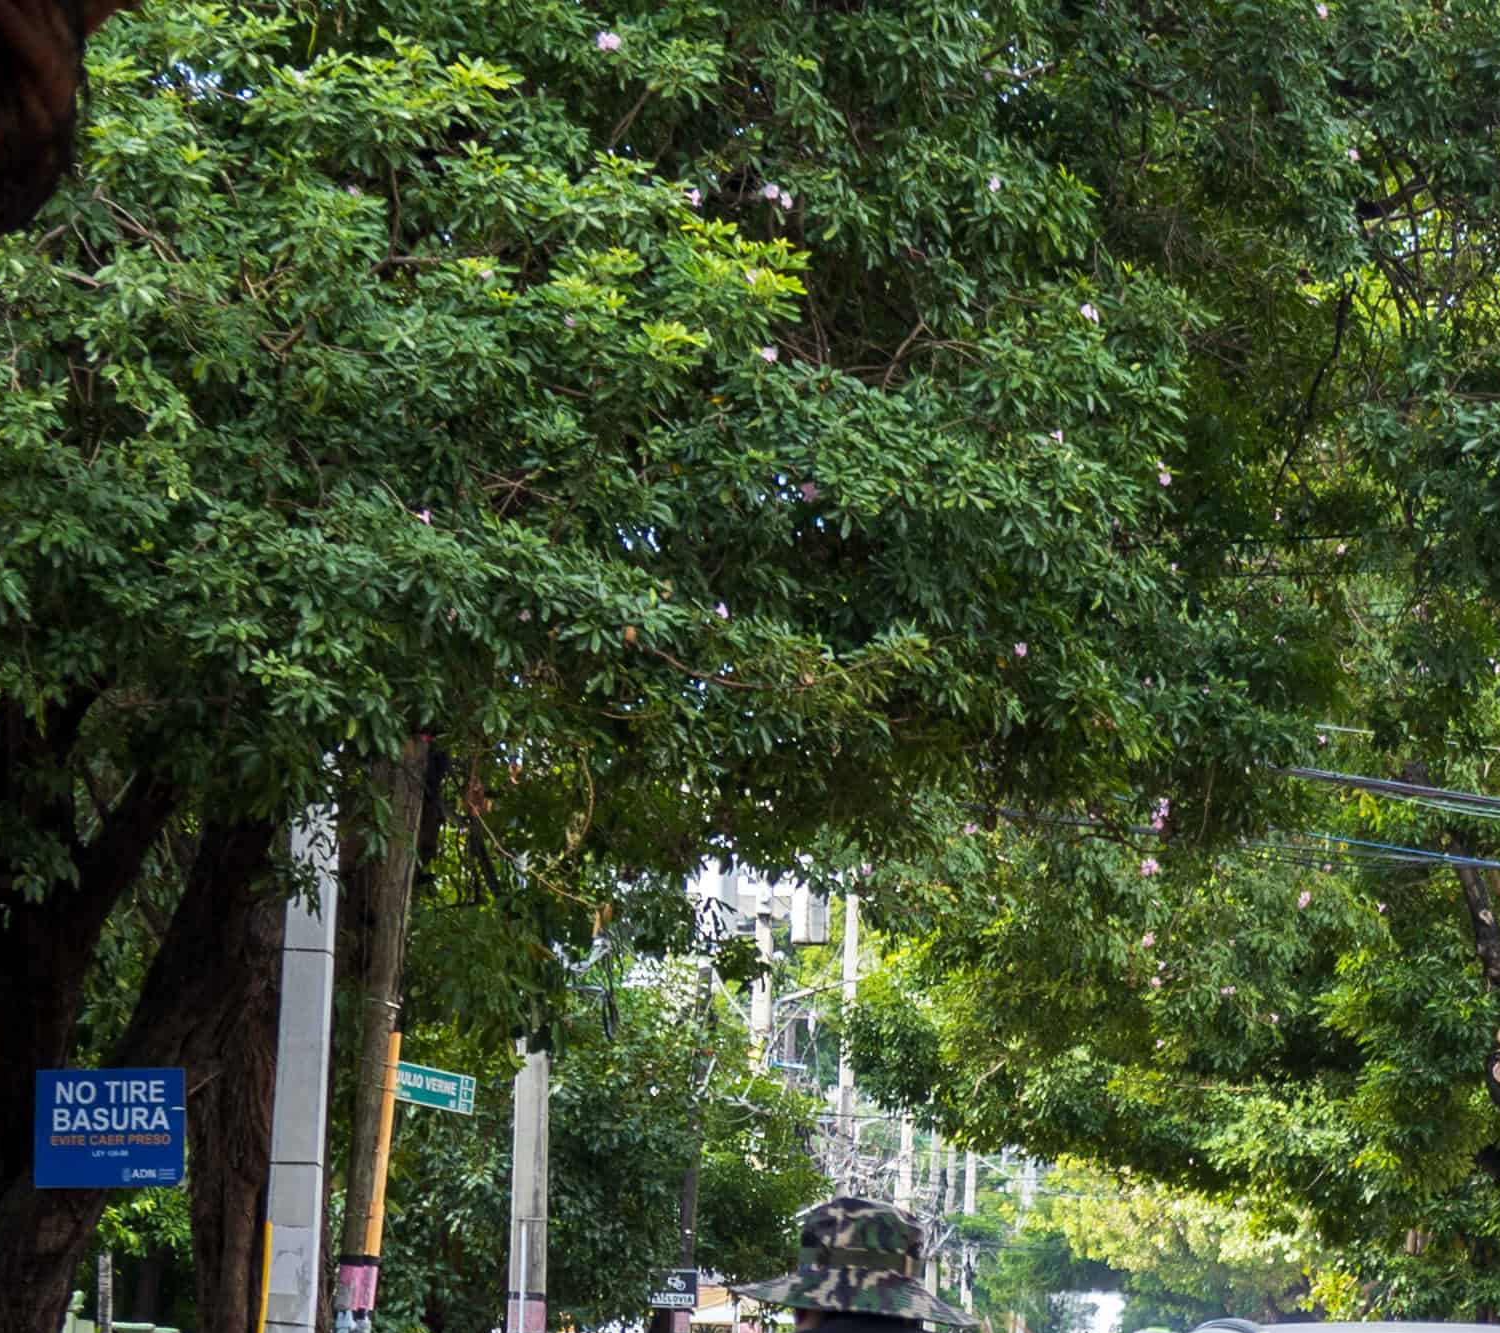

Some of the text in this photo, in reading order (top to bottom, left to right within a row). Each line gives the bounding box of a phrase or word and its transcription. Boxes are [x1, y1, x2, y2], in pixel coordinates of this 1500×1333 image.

[55, 1079, 166, 1105] NO TIRE
[425, 1075, 458, 1097] VERNE
[51, 1106, 171, 1132] BASURA
[50, 1133, 172, 1146] EVITE CAER PRESO
[131, 1168, 157, 1179] ADN
